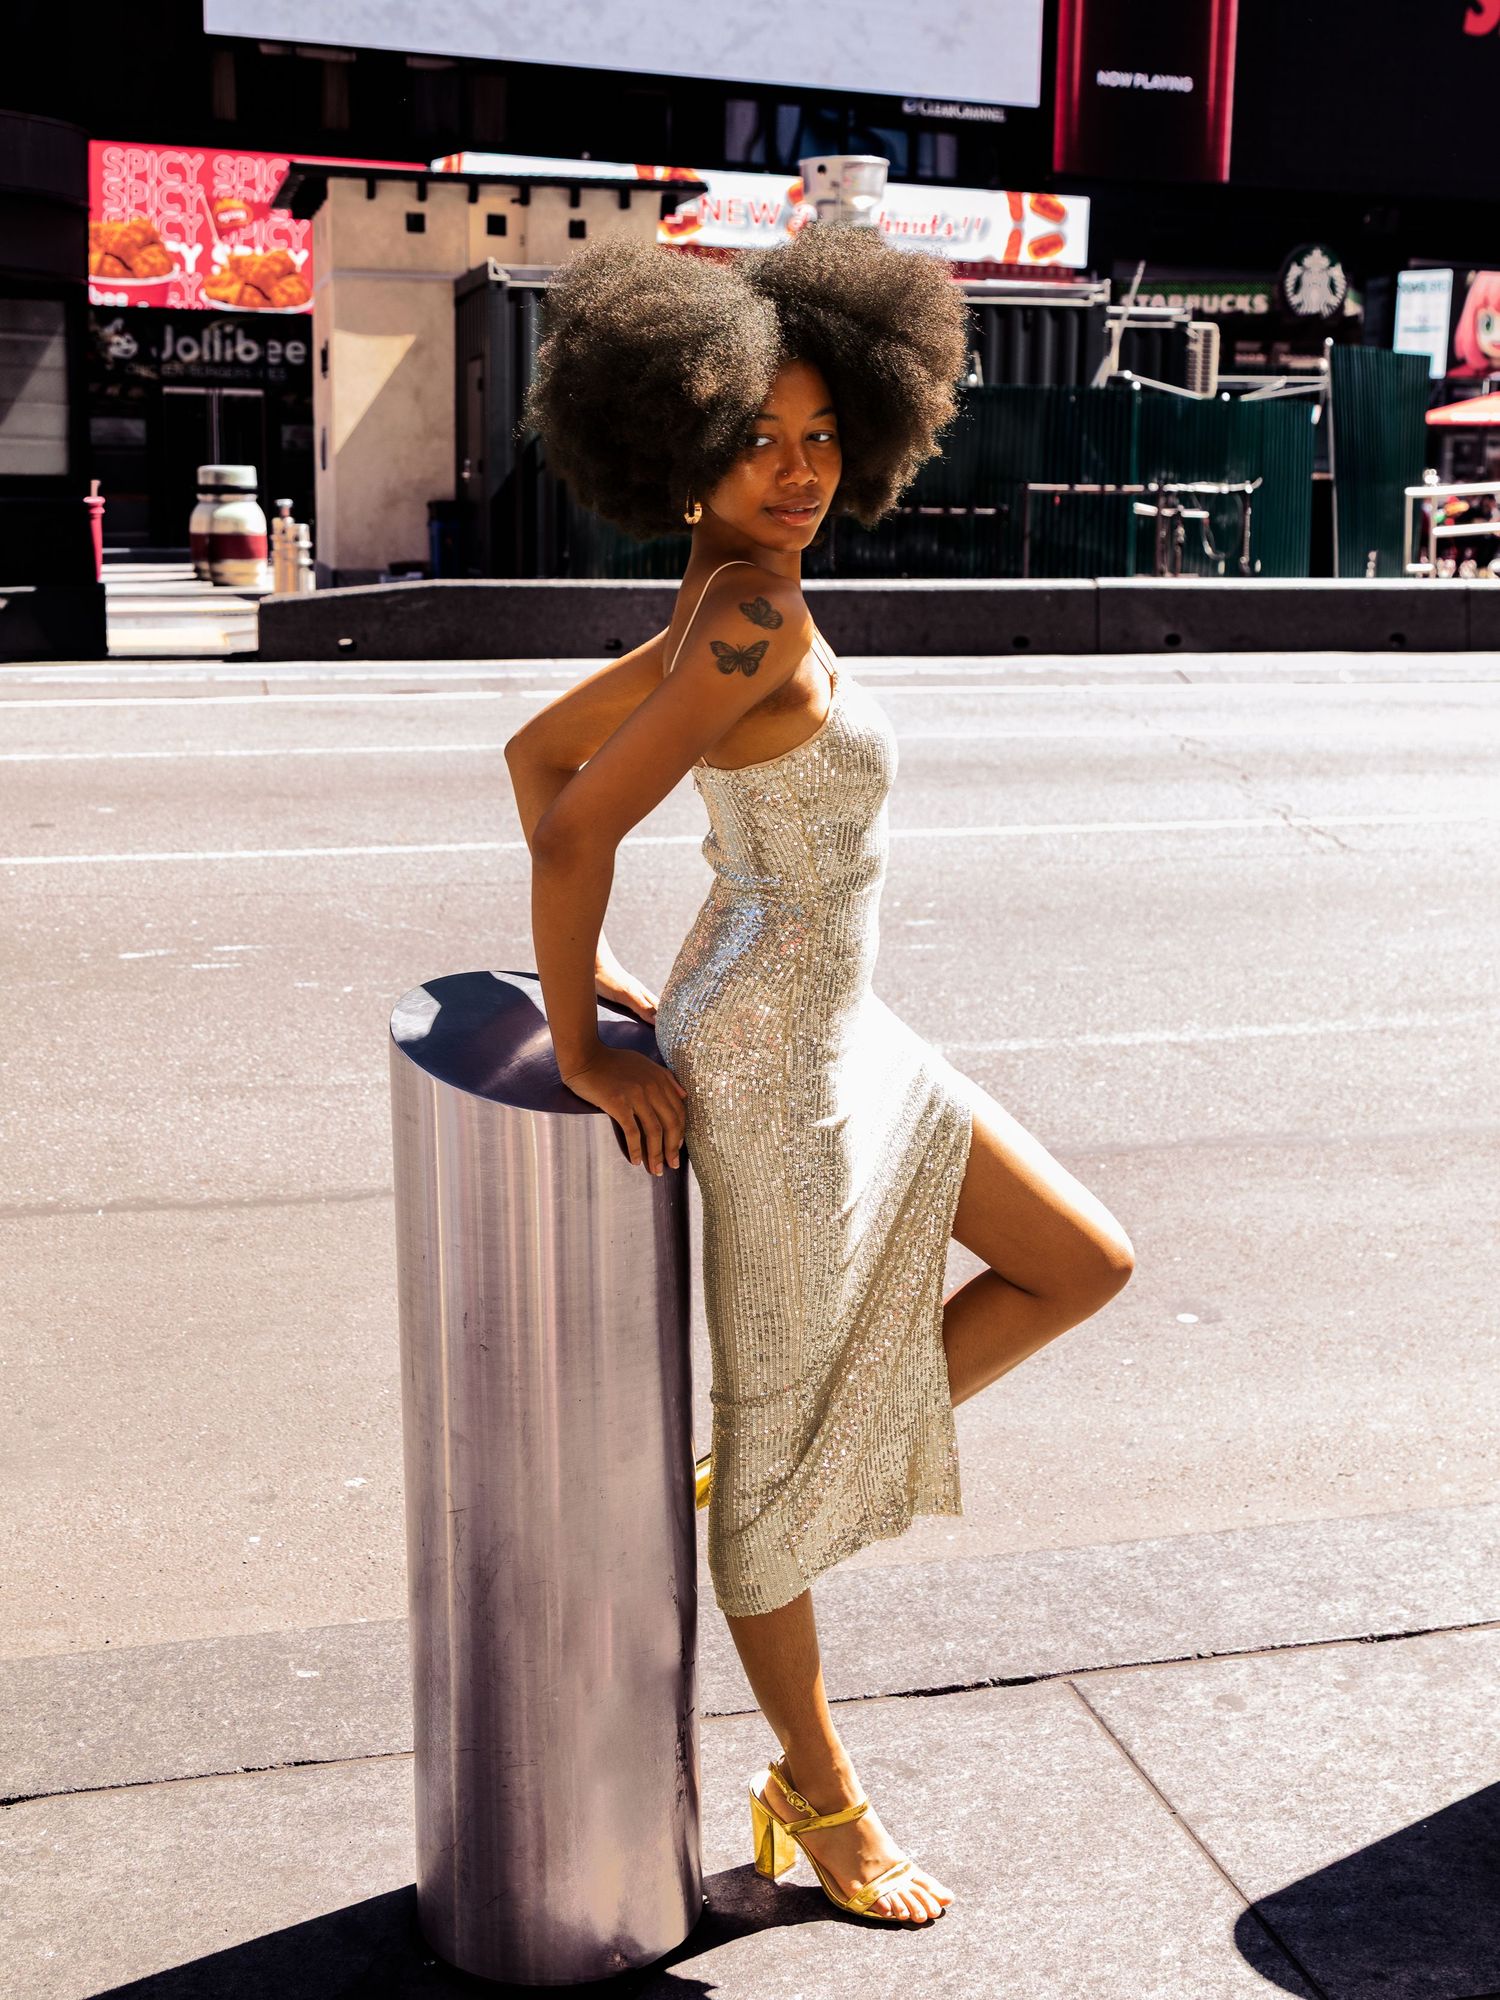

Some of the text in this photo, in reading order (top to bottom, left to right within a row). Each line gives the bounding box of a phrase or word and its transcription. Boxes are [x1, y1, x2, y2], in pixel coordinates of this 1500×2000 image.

[1097, 69, 1193, 92] NOW PLAYING
[102, 147, 290, 193] SPICY SPIC
[102, 179, 205, 214] SPICY
[699, 197, 782, 226] NEW
[152, 324, 307, 364] Jollibee
